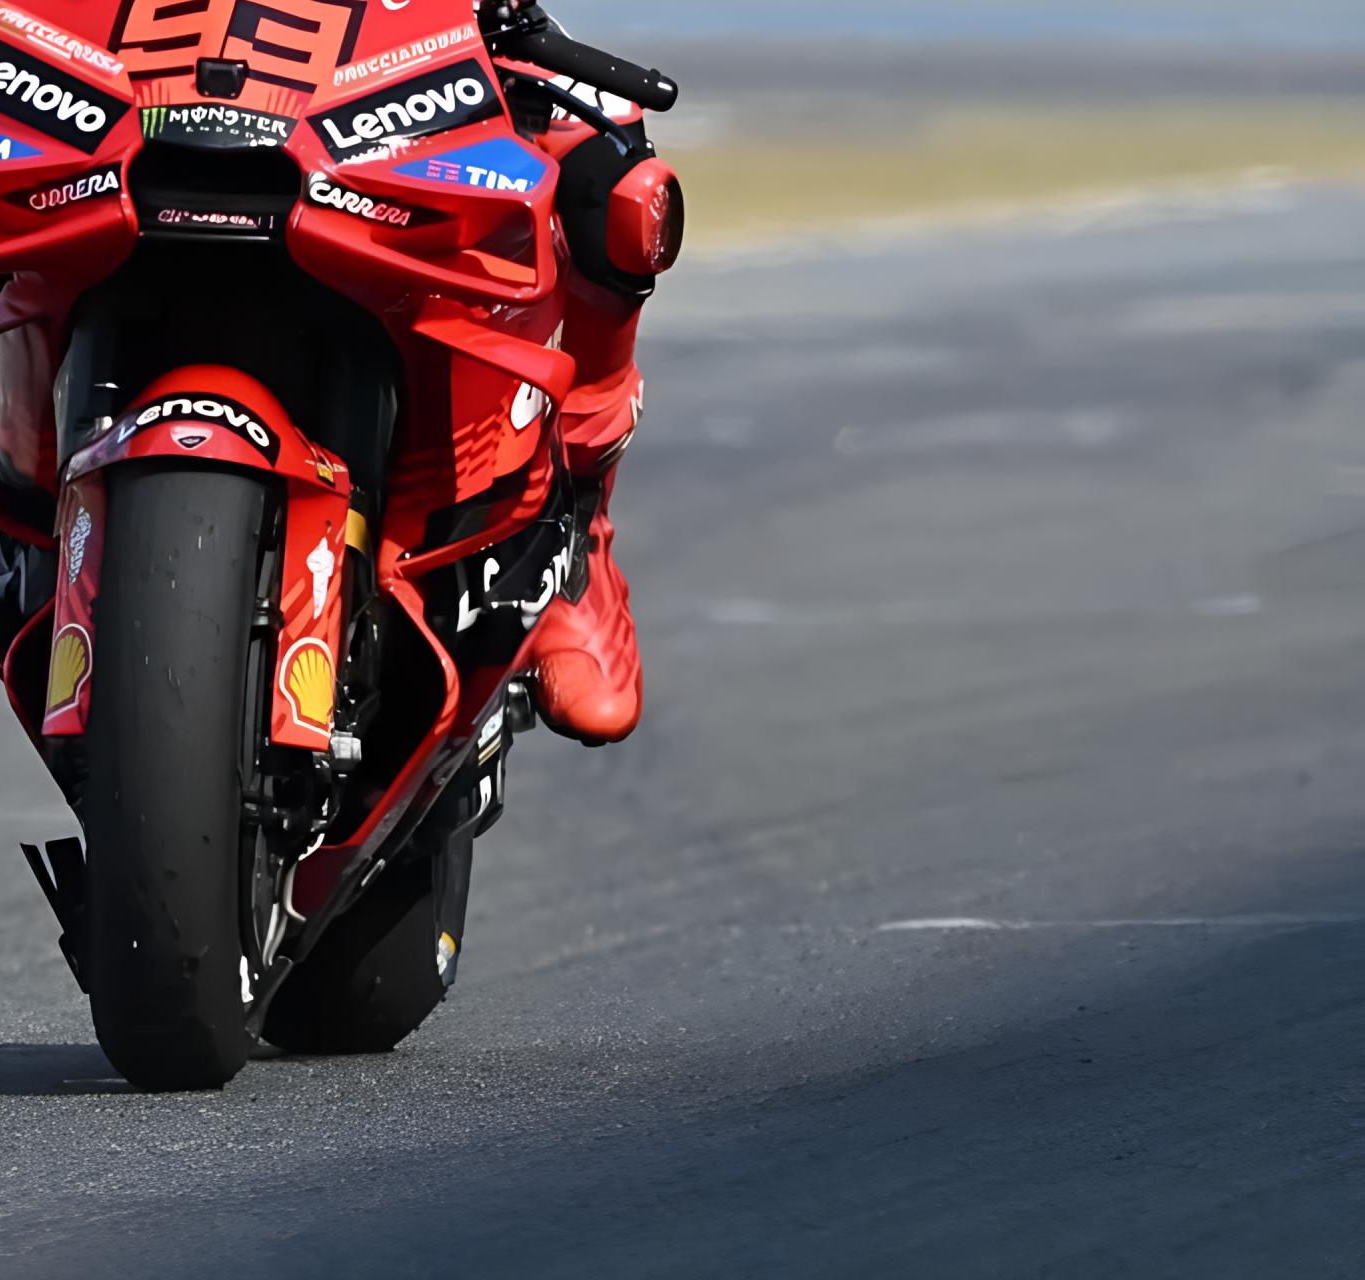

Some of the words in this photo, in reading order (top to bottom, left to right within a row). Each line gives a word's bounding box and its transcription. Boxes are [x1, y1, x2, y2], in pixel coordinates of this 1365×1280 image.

[322, 77, 485, 149] Lenovo
[466, 165, 529, 193] TIM
[310, 182, 411, 226] CARRERA
[117, 398, 270, 448] Lenovo
